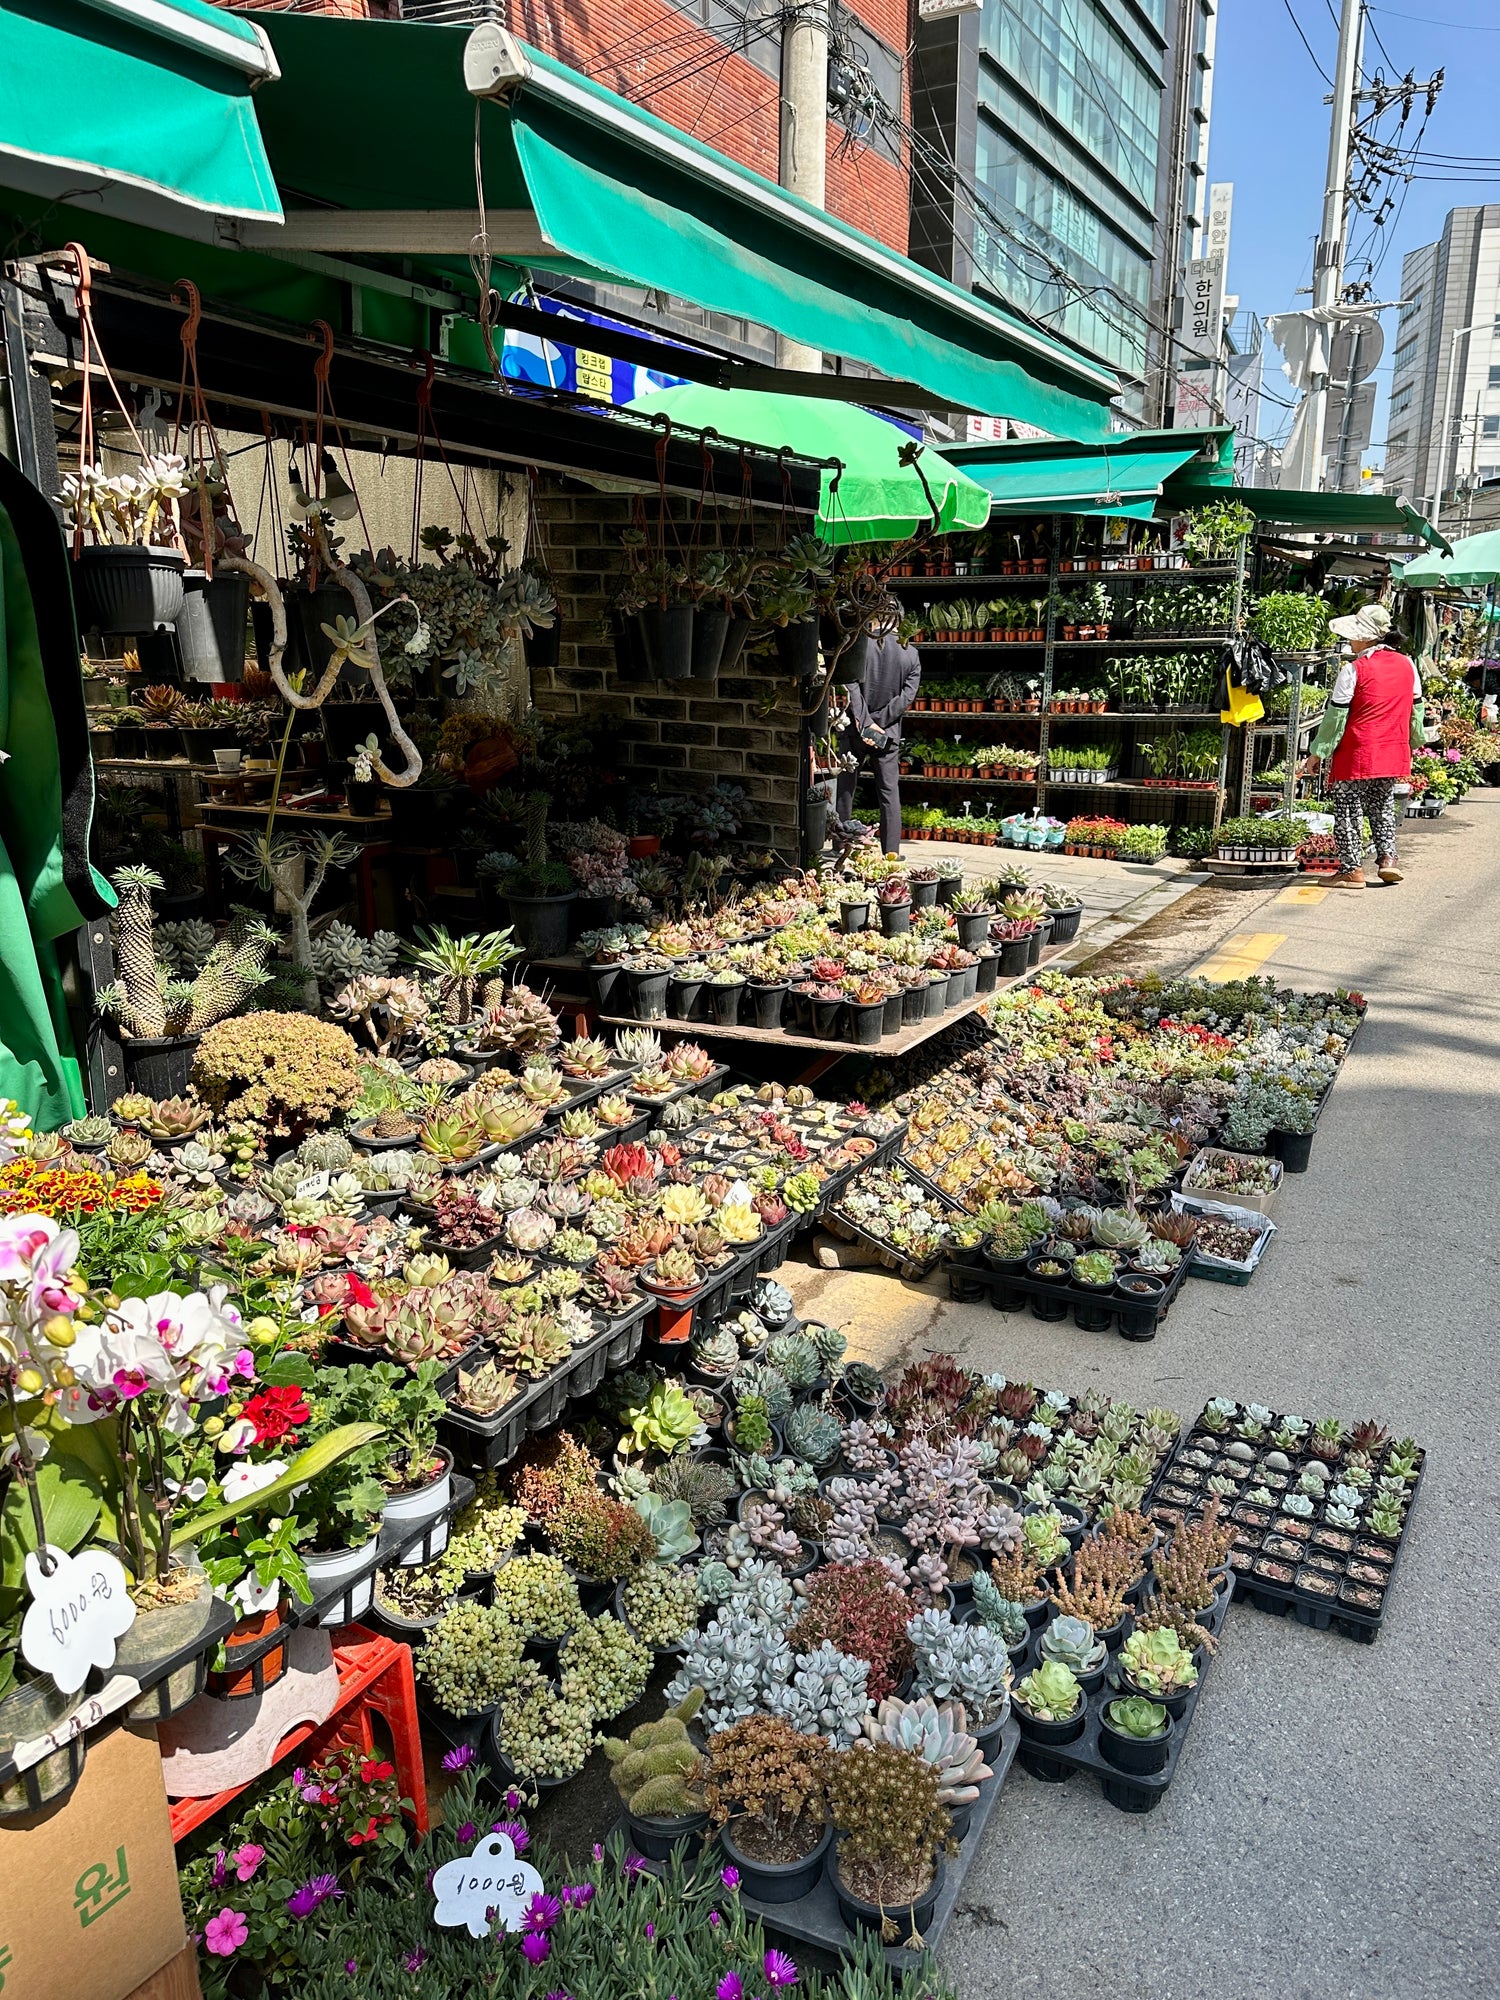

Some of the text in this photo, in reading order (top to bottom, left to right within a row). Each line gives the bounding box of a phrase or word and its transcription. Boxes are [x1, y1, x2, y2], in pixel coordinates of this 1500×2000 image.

[1190, 258, 1222, 278] 다나
[1192, 279, 1213, 338] 한의원
[581, 353, 606, 370] 킹크랩
[582, 372, 607, 389] 랍스타
[73, 1845, 131, 1928] 원
[457, 1872, 526, 1897] 1000원
